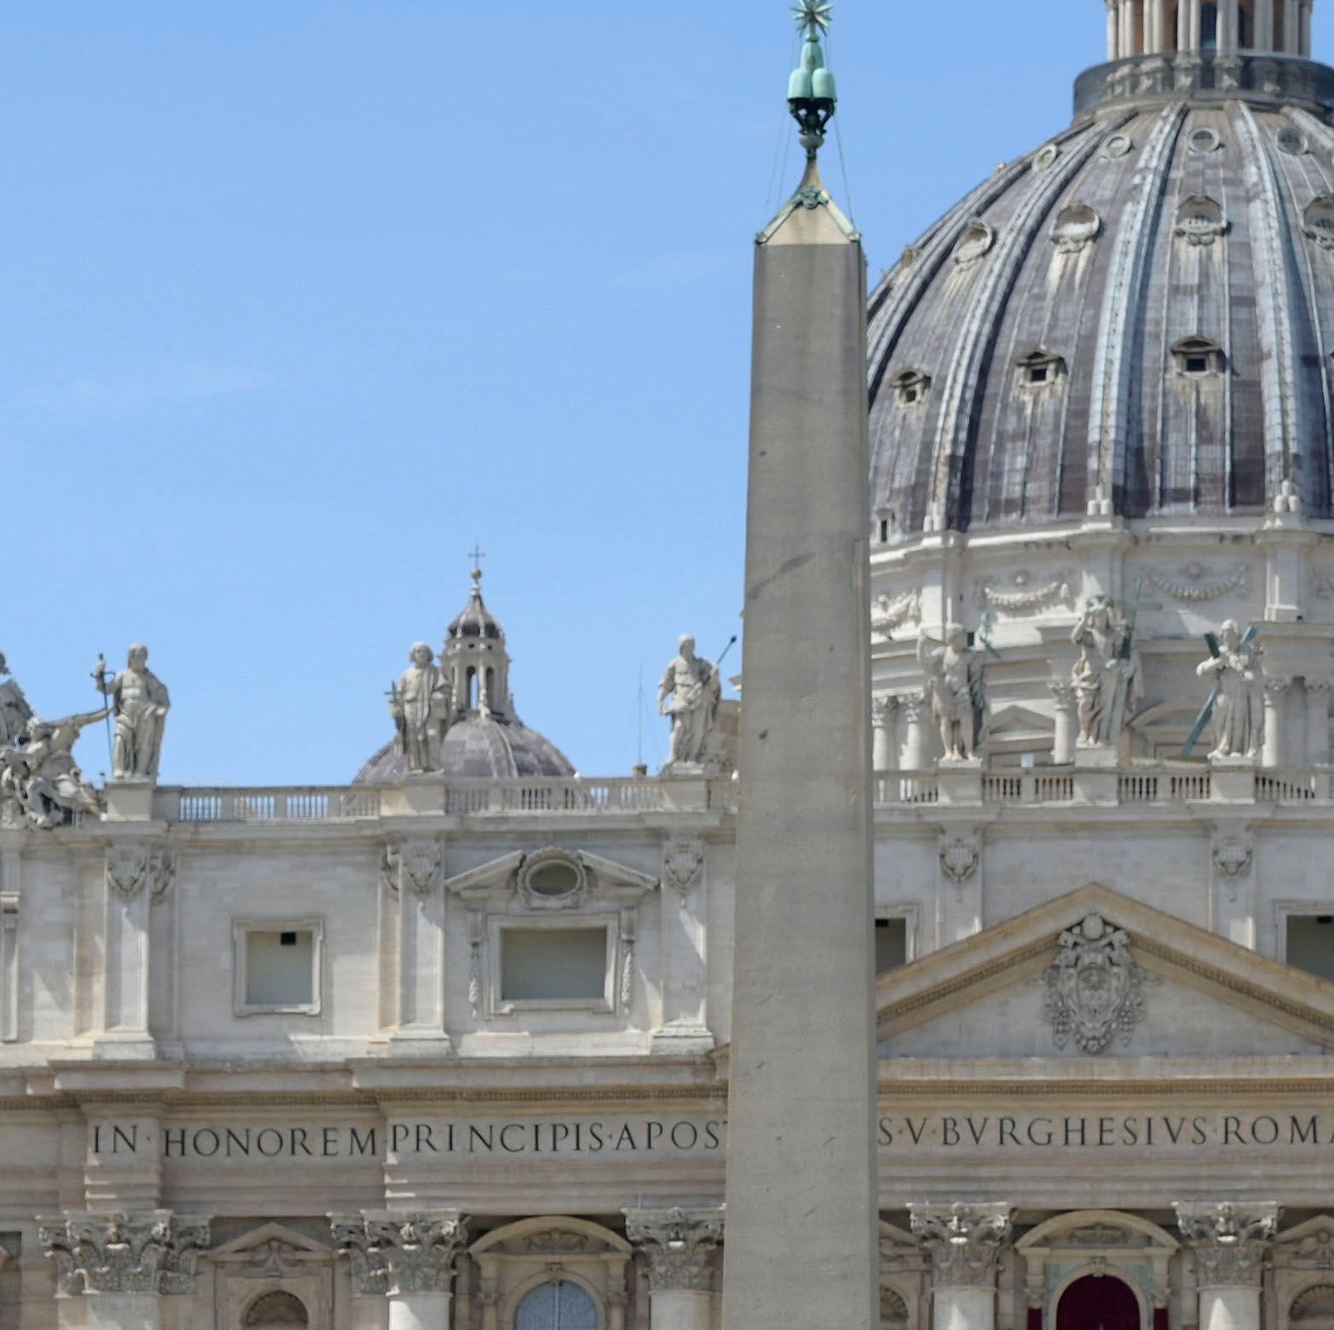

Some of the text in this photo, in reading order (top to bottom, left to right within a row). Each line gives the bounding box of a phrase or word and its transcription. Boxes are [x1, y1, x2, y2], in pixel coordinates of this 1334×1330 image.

[93, 1120, 728, 1157] IN HONOREM PRINCIPIS APOS
[905, 1117, 928, 1146] V
[942, 1115, 1208, 1147] BVRGHESIVS
